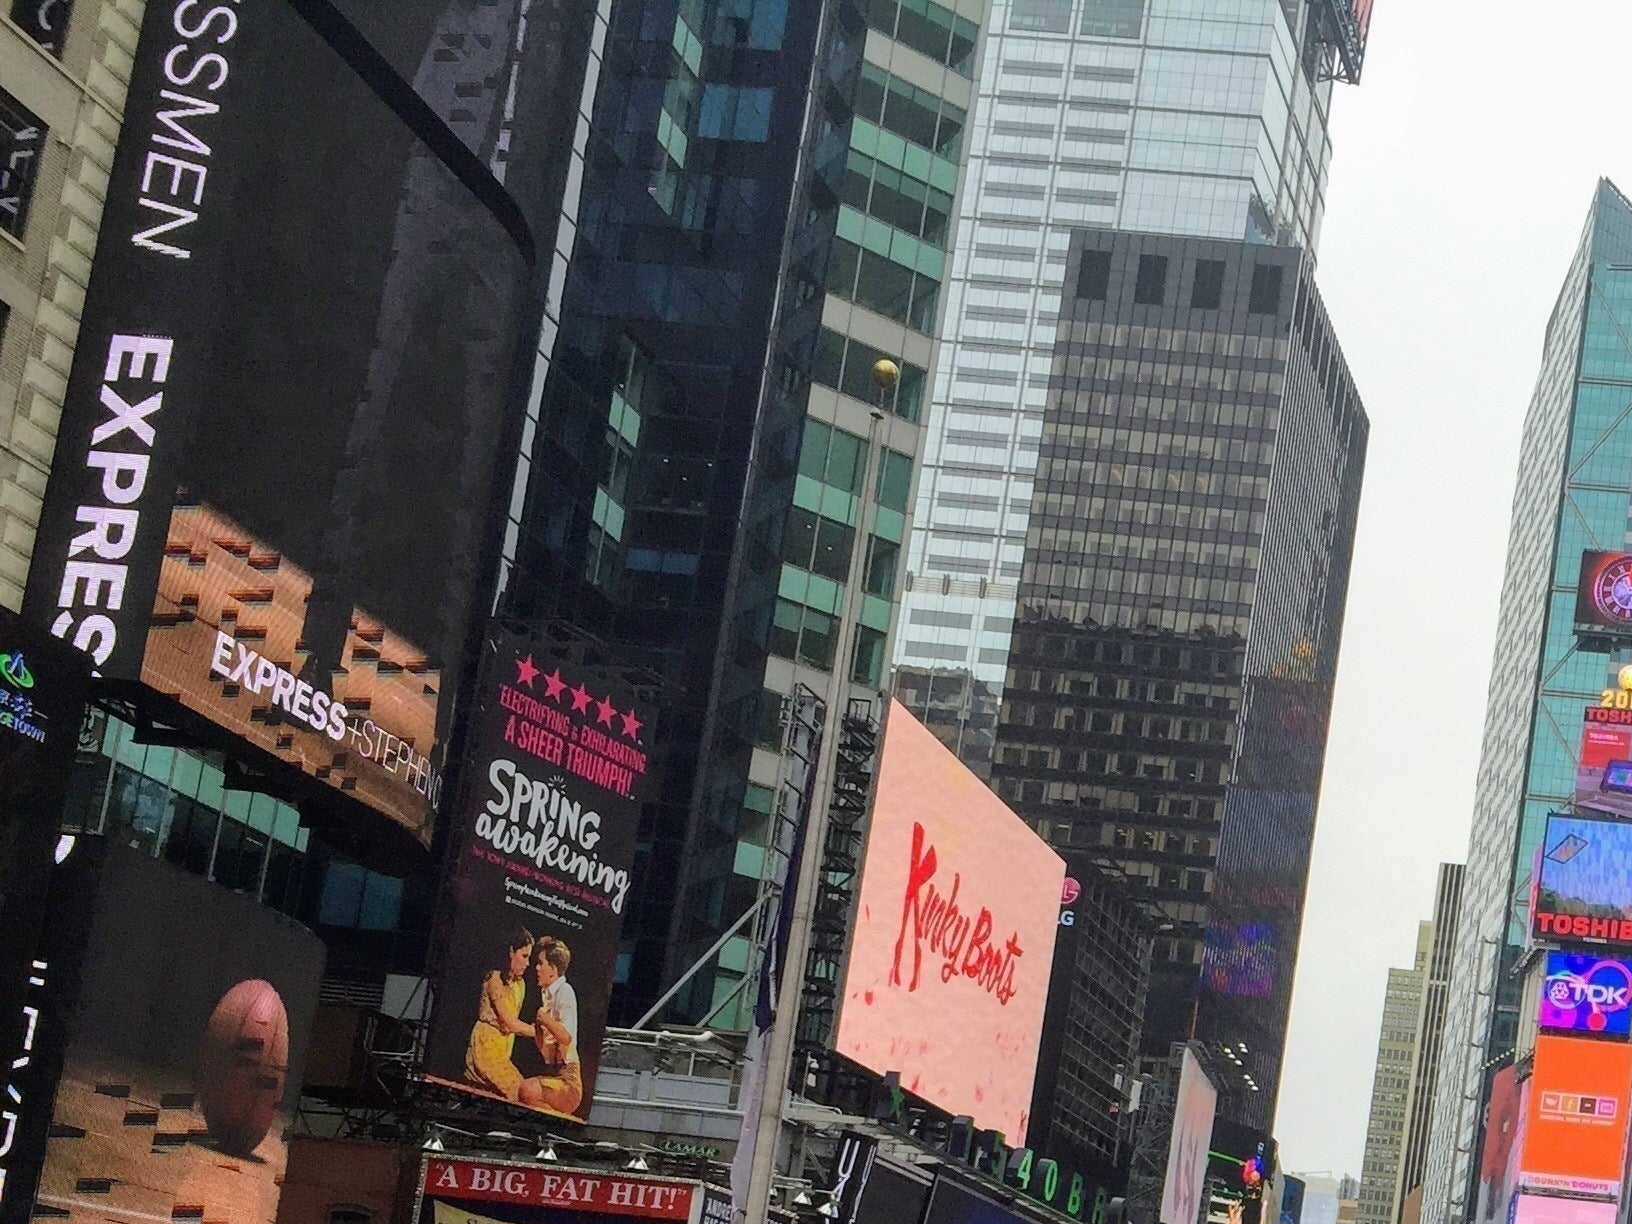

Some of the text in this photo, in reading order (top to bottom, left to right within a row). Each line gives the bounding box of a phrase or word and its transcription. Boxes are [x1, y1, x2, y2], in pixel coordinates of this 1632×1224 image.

[211, 630, 348, 741] EXPRESS
[504, 714, 633, 798] A SHEER TRIUMPH!
[486, 759, 600, 850] SPRING
[475, 812, 631, 914] awakening
[889, 821, 1024, 1006] Kinky Boots
[1569, 983, 1628, 1008] TDK
[470, 1168, 530, 1198] BIG,
[540, 1175, 601, 1202] FAT
[663, 1141, 717, 1157] LAMAR
